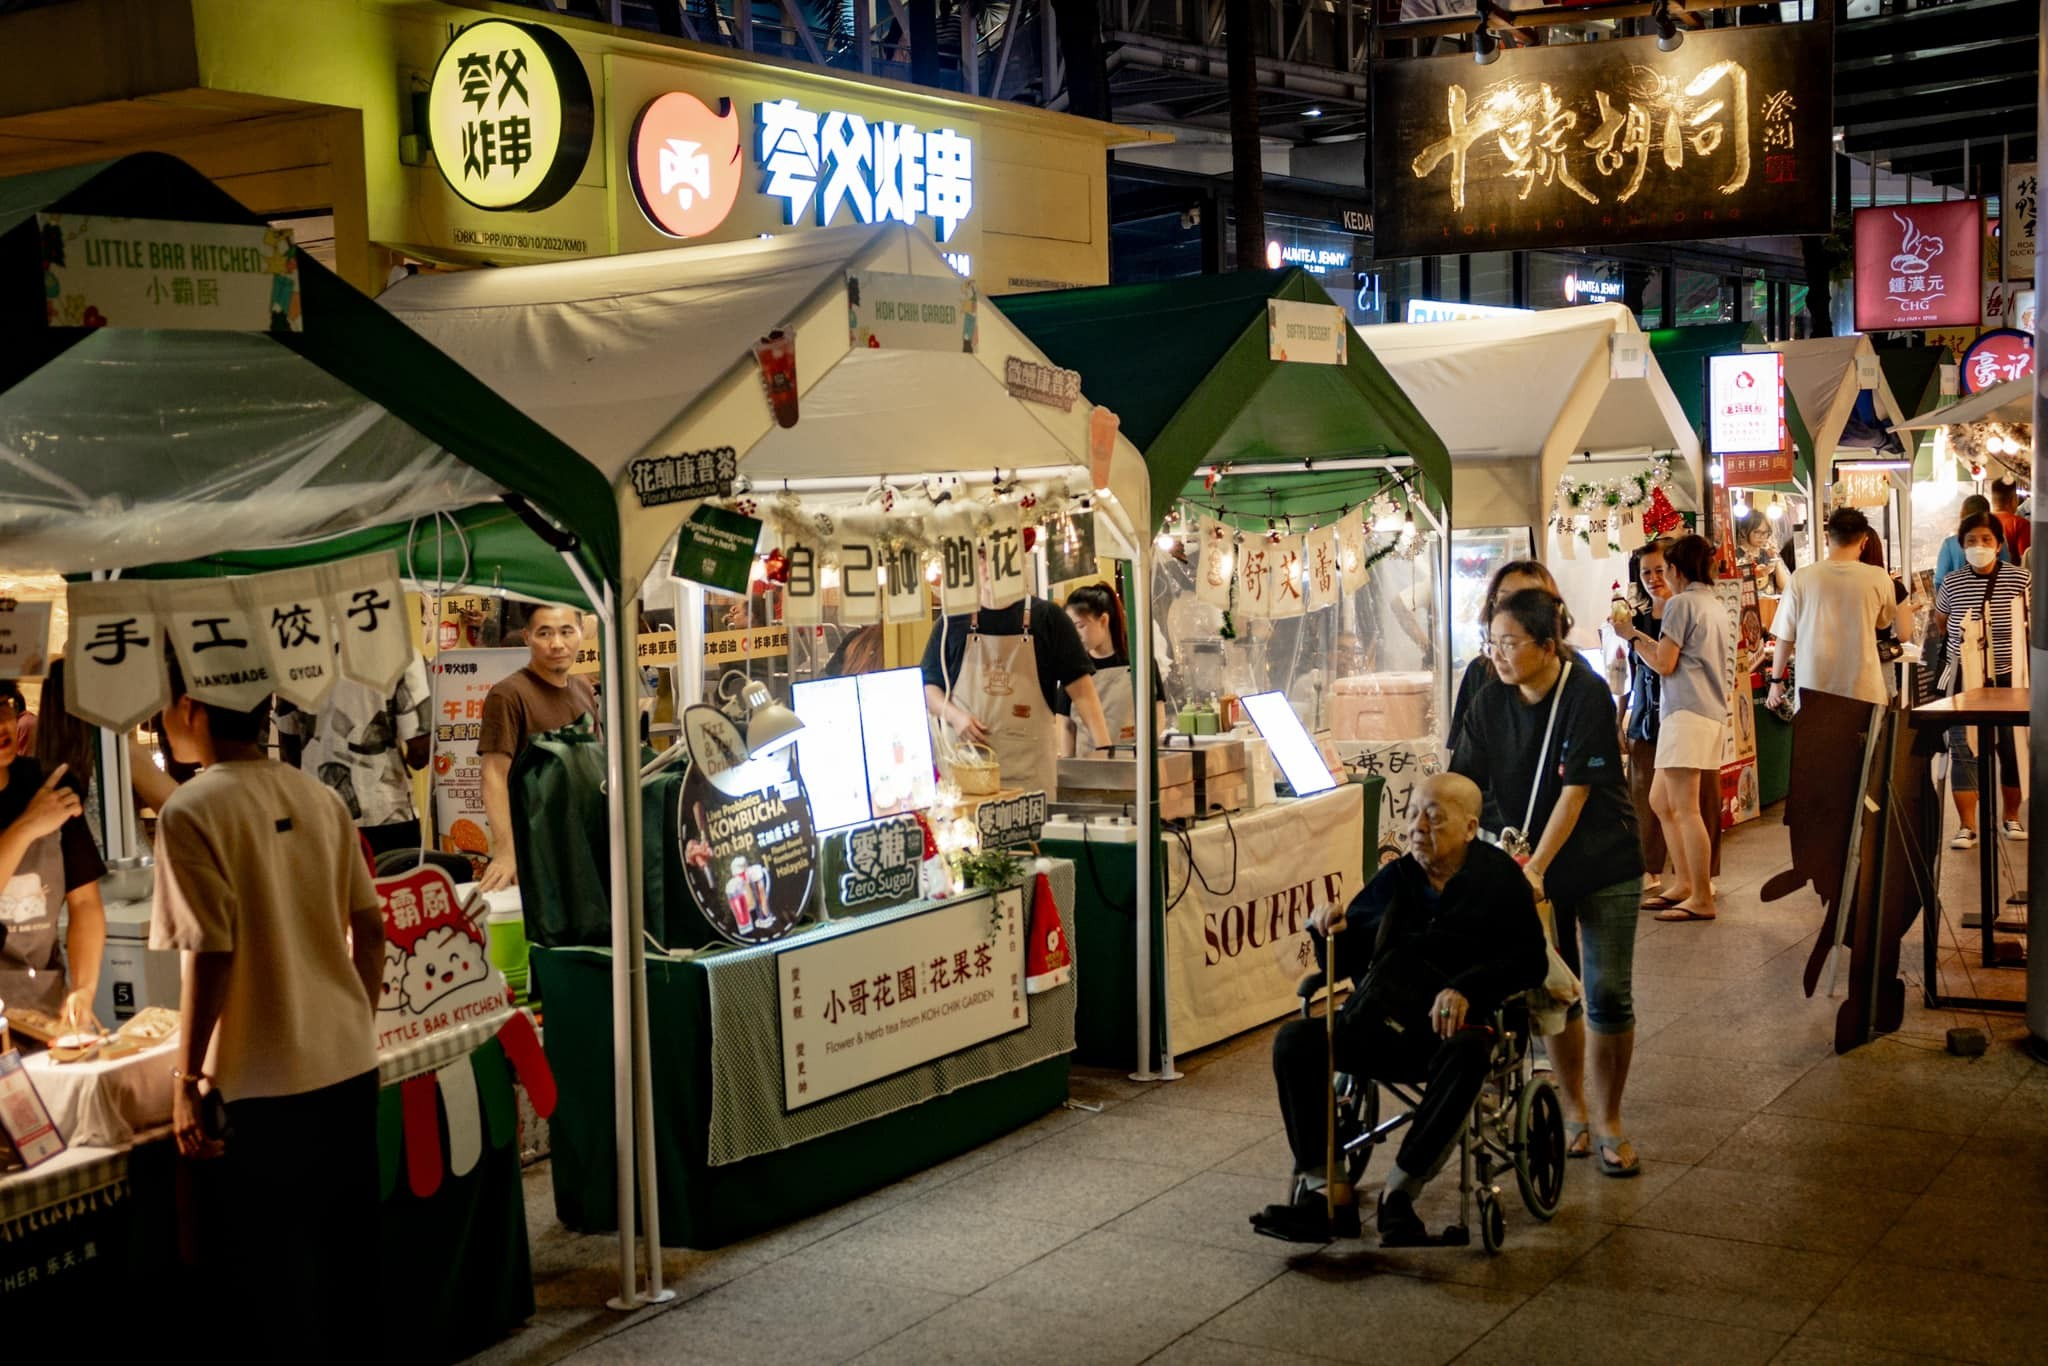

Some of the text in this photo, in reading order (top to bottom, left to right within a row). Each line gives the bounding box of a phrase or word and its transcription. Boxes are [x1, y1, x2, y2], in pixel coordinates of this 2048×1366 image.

[457, 48, 529, 115] 夸父
[462, 115, 532, 182] 炸串
[755, 98, 973, 243] 夸父炸串
[85, 240, 262, 273] LITTLE BAR KITCHEN
[1317, 250, 1345, 266] JENNY
[922, 304, 956, 324] GARDEN
[1901, 300, 1929, 312] CHG
[671, 483, 718, 499] Kombucha
[84, 589, 390, 665] 手工饺子
[195, 664, 324, 688] HANDMADE GYOZA
[708, 799, 788, 842] KOMBUCHA
[980, 796, 1045, 835] 零咖啡因
[714, 832, 754, 858] on tap
[852, 823, 906, 880] 零糖
[848, 870, 914, 898] Zero Sugar
[118, 985, 129, 1002] 5
[823, 942, 993, 1024] 小哥花園 花果茶
[424, 1013, 448, 1033] BAR
[453, 992, 503, 1022] KITCHEN
[826, 1036, 854, 1054] Flower
[857, 1031, 864, 1045] &
[865, 1026, 885, 1041] herb
[886, 1022, 899, 1034] tea
[900, 1016, 920, 1031] from
[921, 1008, 940, 1022] KOH
[962, 989, 994, 1009] GARDEN
